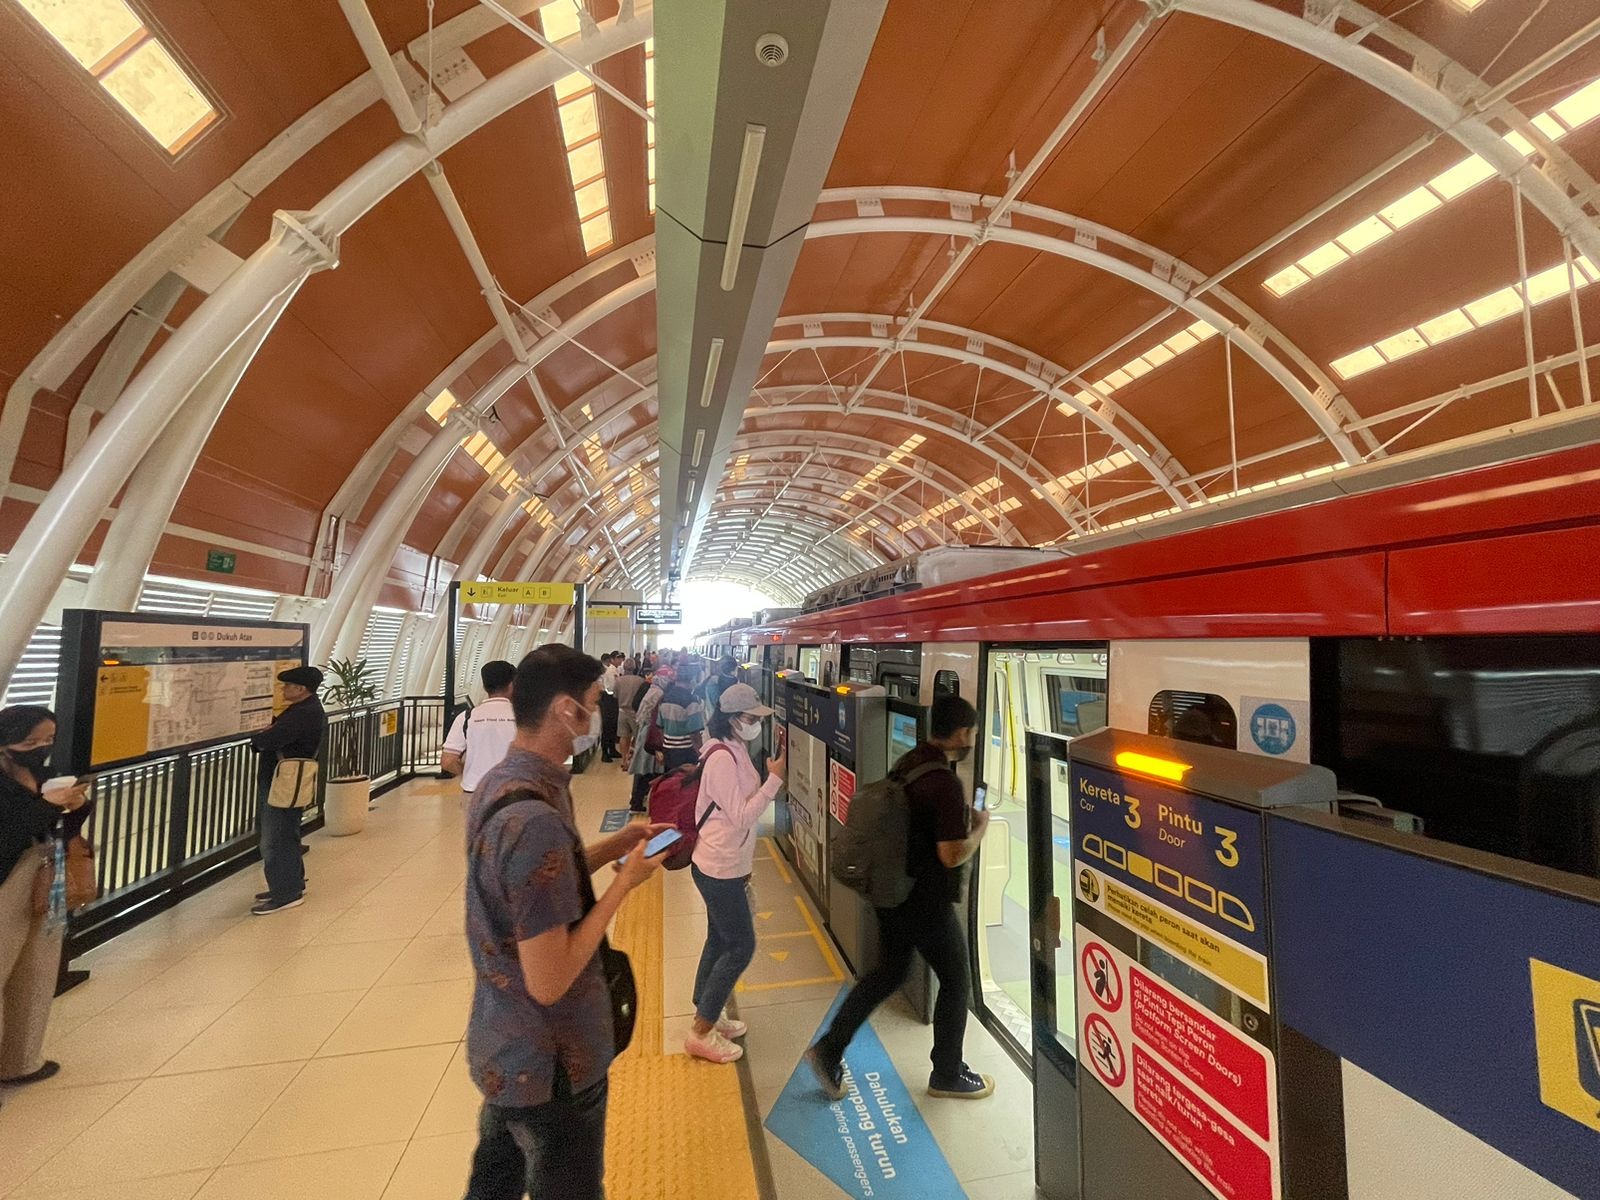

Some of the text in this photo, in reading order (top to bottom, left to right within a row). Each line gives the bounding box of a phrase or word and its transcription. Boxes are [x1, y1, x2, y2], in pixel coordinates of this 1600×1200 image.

[1079, 777, 1240, 868] Kereta 3 Pintu 3
[1080, 798, 1186, 848] Car Door
[1131, 906, 1153, 924] kereta
[1160, 915, 1180, 931] peron
[1182, 927, 1199, 942] saat
[1200, 937, 1220, 953] akan
[1133, 976, 1216, 1041] Dilarang bersandar
[1134, 989, 1215, 1054] di Pintu Tepi Peron
[1134, 998, 1242, 1087] (Platform Screen Doors)
[864, 1071, 908, 1145] Dahulukan
[1136, 1067, 1203, 1130] saat naik/turun
[1136, 1054, 1235, 1146] Dilarang tergesa-gesa
[1137, 1076, 1163, 1107] kereta
[841, 1135, 874, 1197] passengers
[868, 1132, 897, 1180] turun
